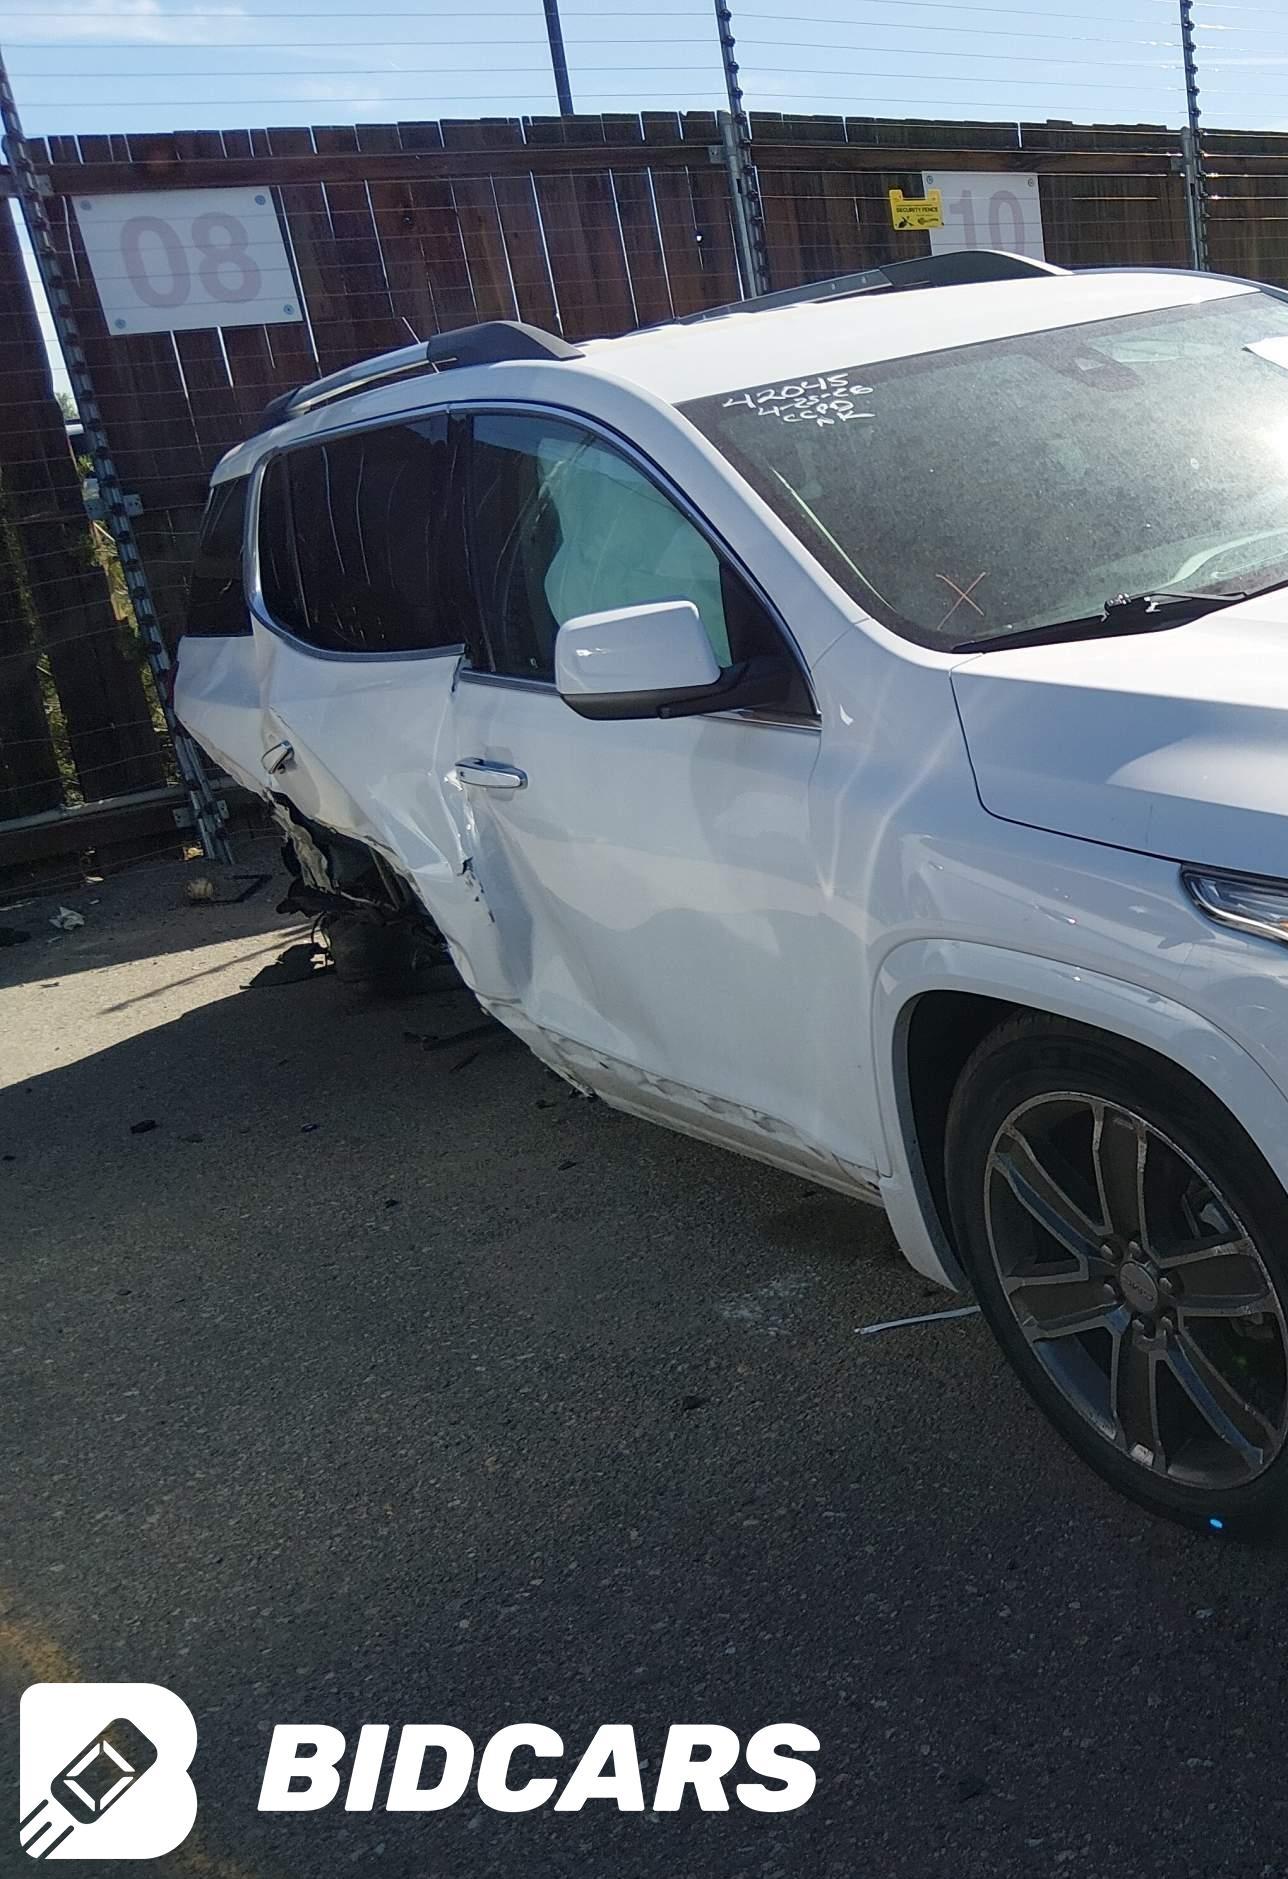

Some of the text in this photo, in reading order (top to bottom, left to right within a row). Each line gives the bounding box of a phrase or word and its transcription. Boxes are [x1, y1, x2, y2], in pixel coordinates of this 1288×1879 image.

[949, 189, 1025, 257] 10
[120, 212, 261, 308] 08
[721, 373, 848, 409] 42045
